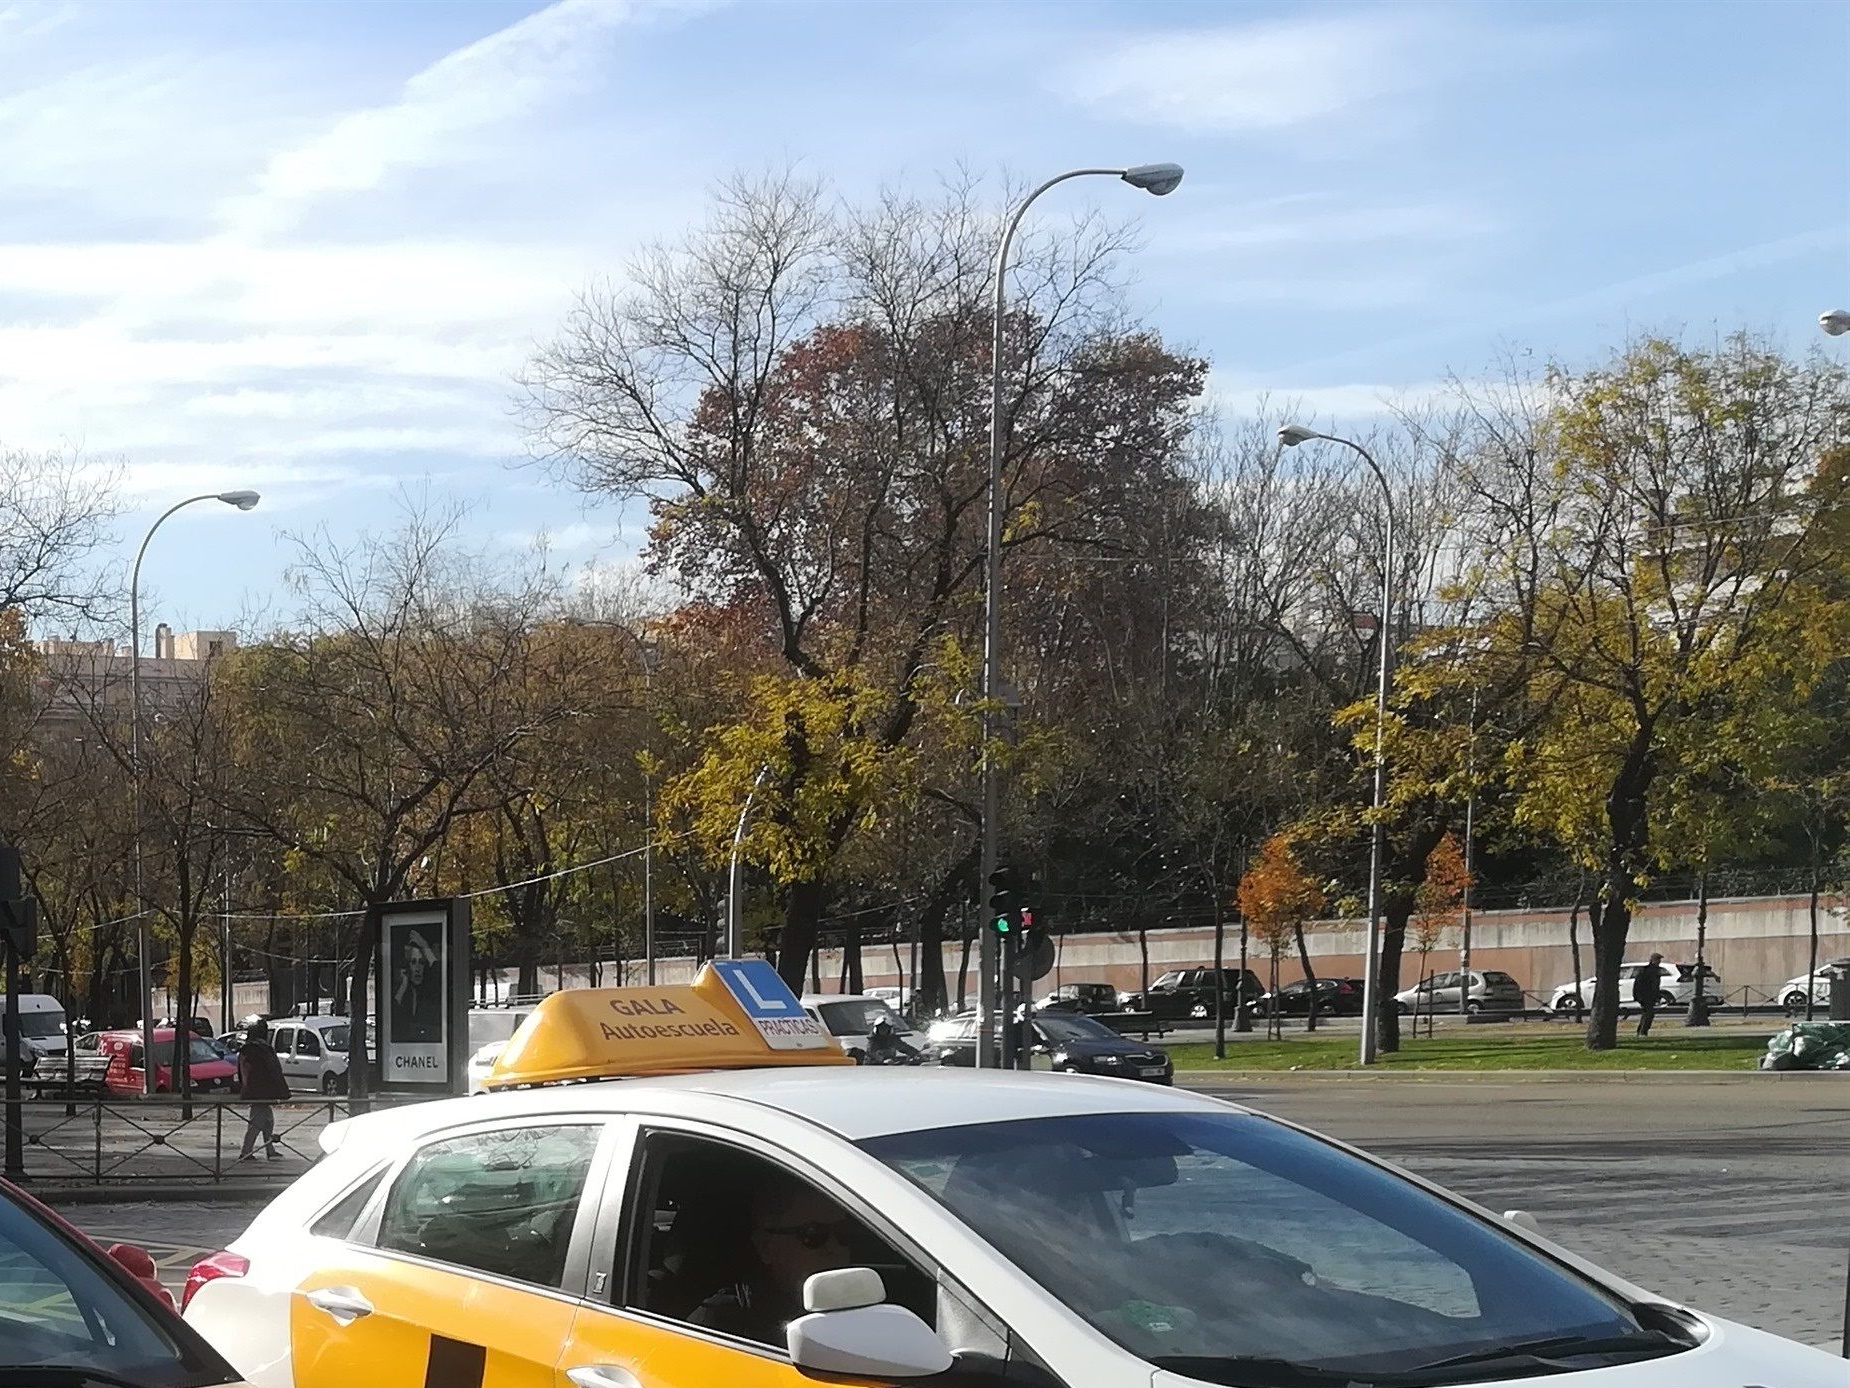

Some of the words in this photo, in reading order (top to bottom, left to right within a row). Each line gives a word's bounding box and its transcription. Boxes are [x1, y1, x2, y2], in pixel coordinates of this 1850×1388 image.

[732, 969, 787, 1010] L
[610, 998, 685, 1016] GALA
[599, 1018, 740, 1041] Autoescuela
[758, 1018, 819, 1036] PRACTICAS
[395, 1056, 439, 1069] CHANEL
